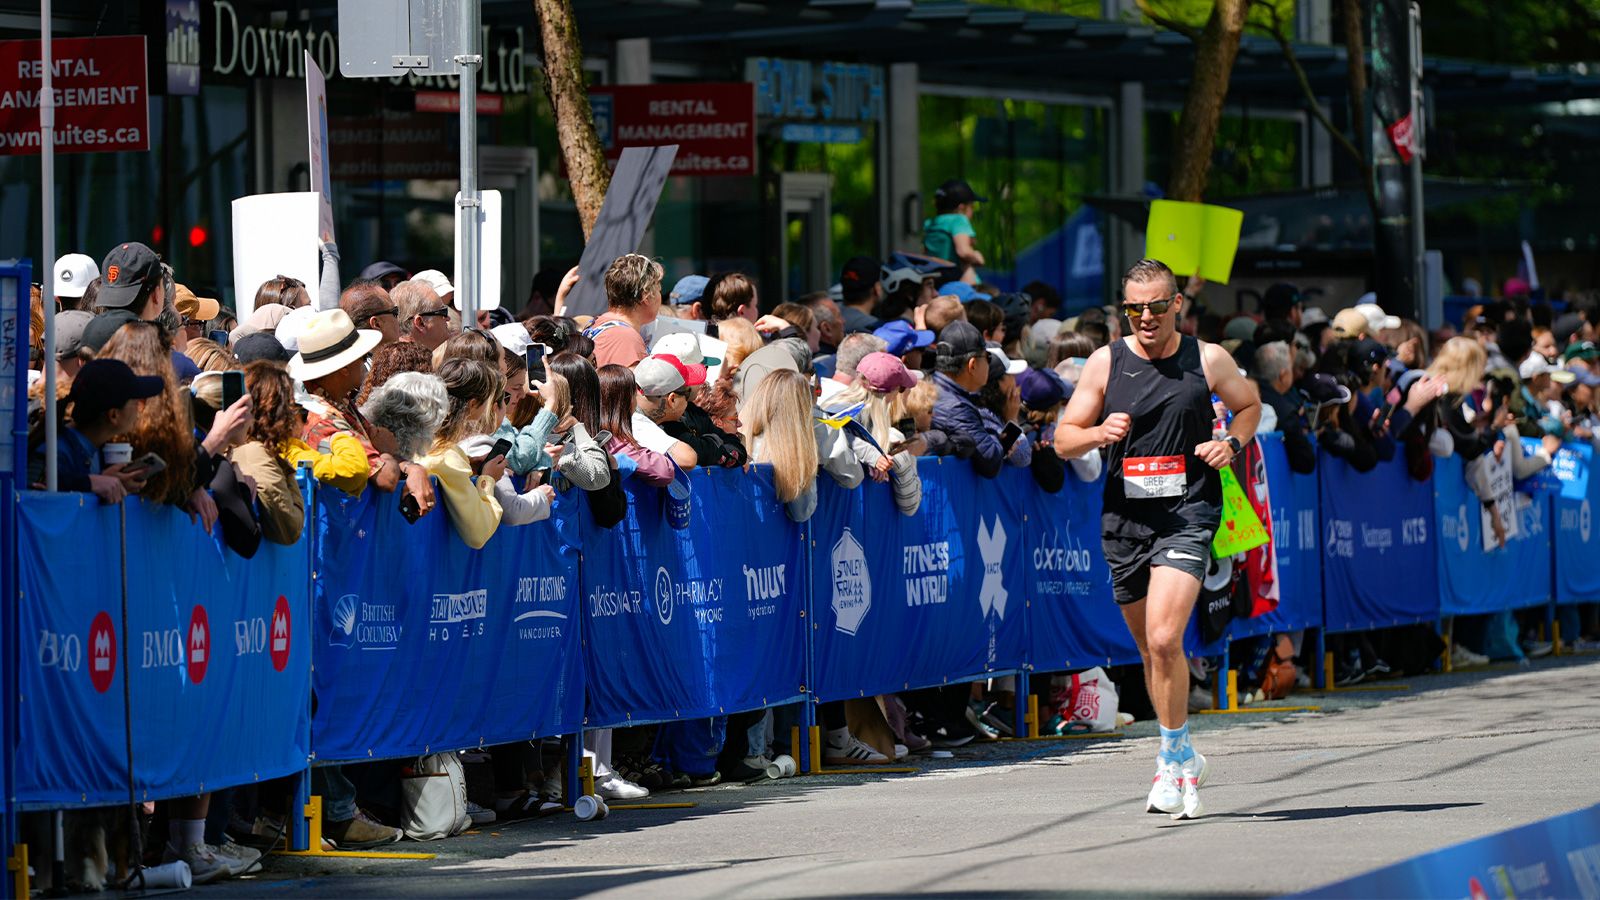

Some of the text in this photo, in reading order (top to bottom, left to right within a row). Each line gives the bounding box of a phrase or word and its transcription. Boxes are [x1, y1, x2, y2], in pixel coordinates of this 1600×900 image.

[213, 1, 378, 83] Downto
[18, 58, 100, 78] RENTAL
[648, 100, 717, 115] RENTAL
[618, 123, 747, 140] MANAGEMENT
[1143, 476, 1164, 487] GREG
[1401, 516, 1427, 545] KITS
[903, 541, 949, 574] FITNESS
[519, 626, 562, 640] VANCOUVER
[141, 629, 183, 668] BMO
